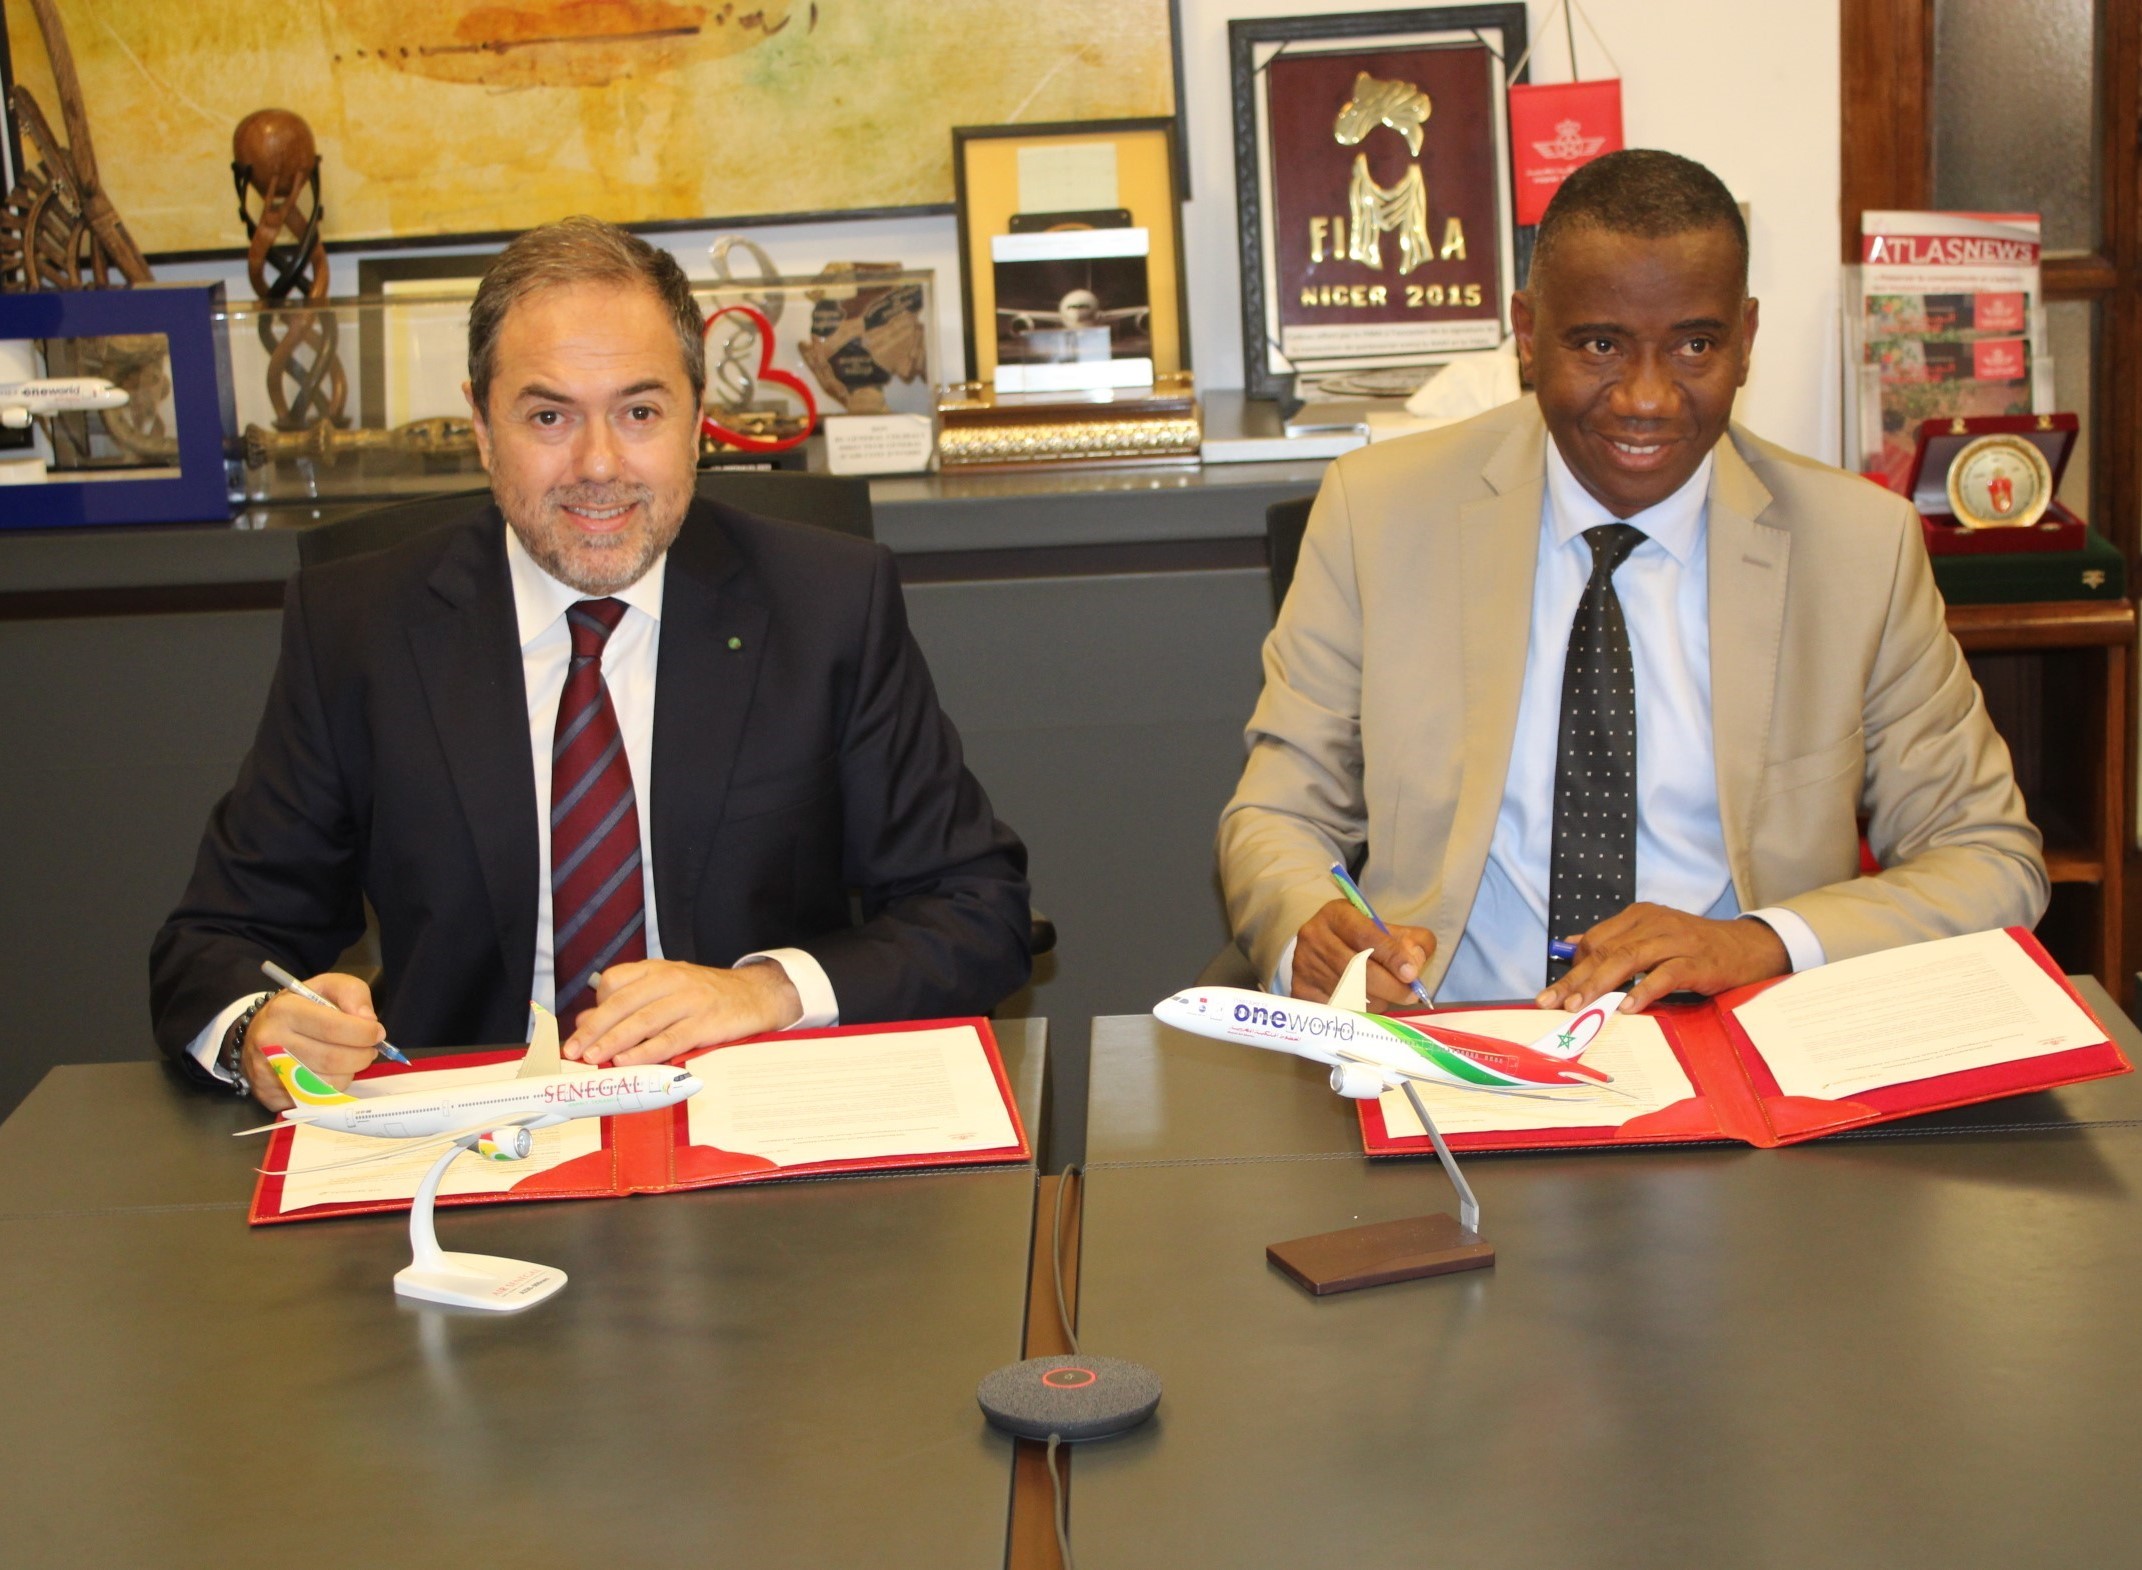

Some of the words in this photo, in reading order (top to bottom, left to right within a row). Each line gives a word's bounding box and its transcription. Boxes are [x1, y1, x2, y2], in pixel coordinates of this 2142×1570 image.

[1301, 285, 1387, 307] NIGER
[1405, 284, 1482, 307] 2015
[22, 386, 80, 397] oneworld
[1234, 1004, 1355, 1041] oneworld
[544, 1076, 643, 1103] SENEGAL
